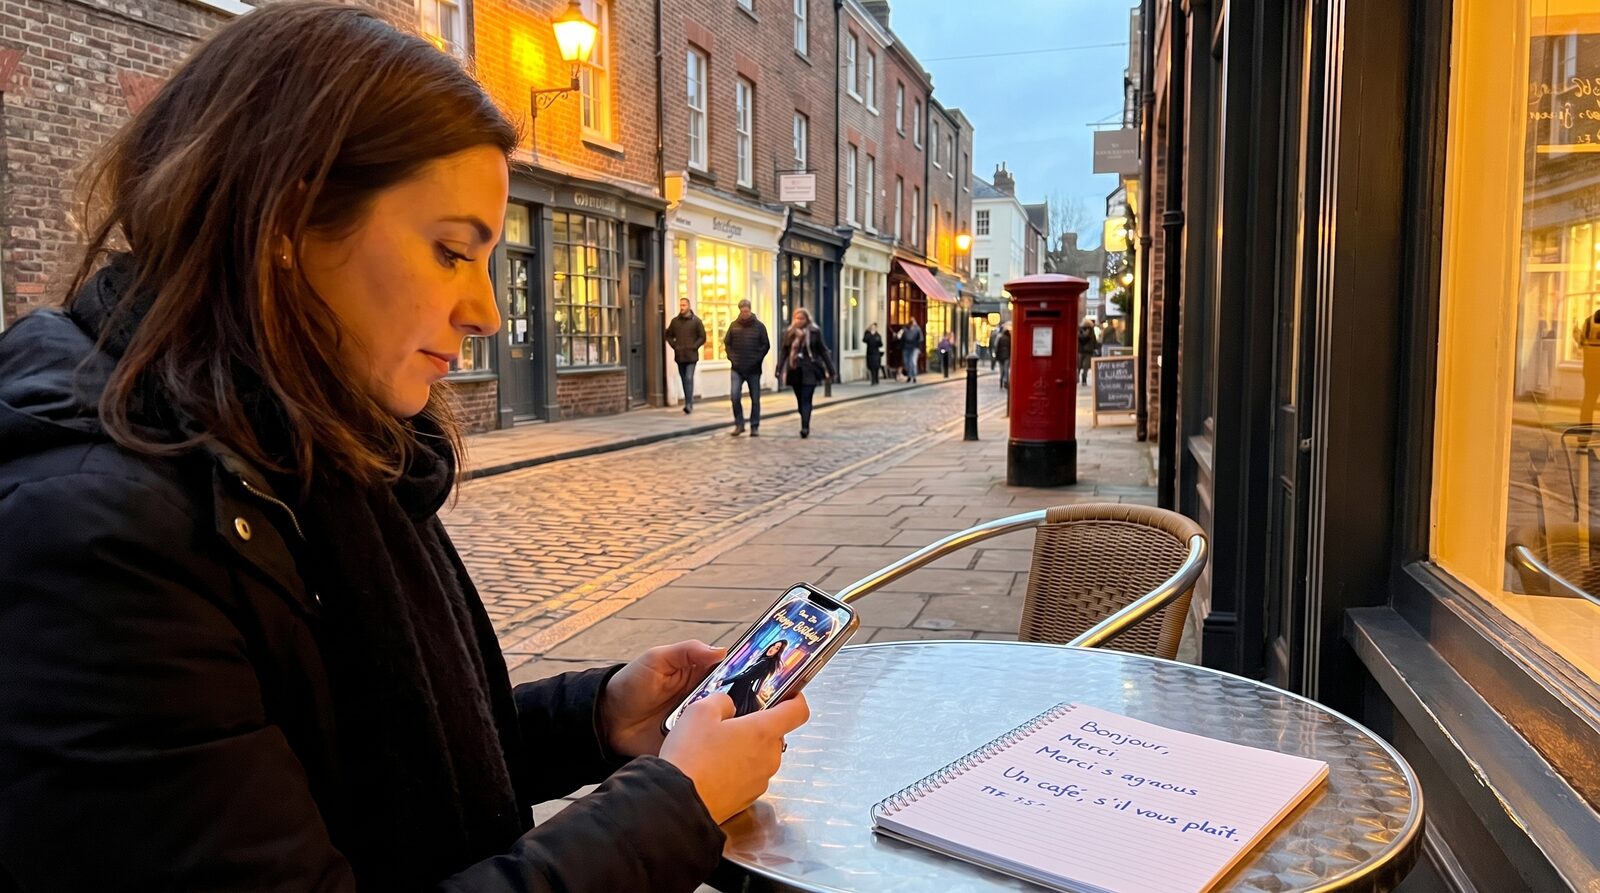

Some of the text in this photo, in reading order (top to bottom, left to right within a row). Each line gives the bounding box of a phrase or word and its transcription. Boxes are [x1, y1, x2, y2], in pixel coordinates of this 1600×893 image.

[1079, 721, 1170, 756] Bonjour,
[1035, 745, 1099, 771] Merci
[1002, 766, 1031, 784] Un
[1037, 781, 1088, 802] café,
[1092, 797, 1132, 811] s'il
[1136, 808, 1179, 825] vous
